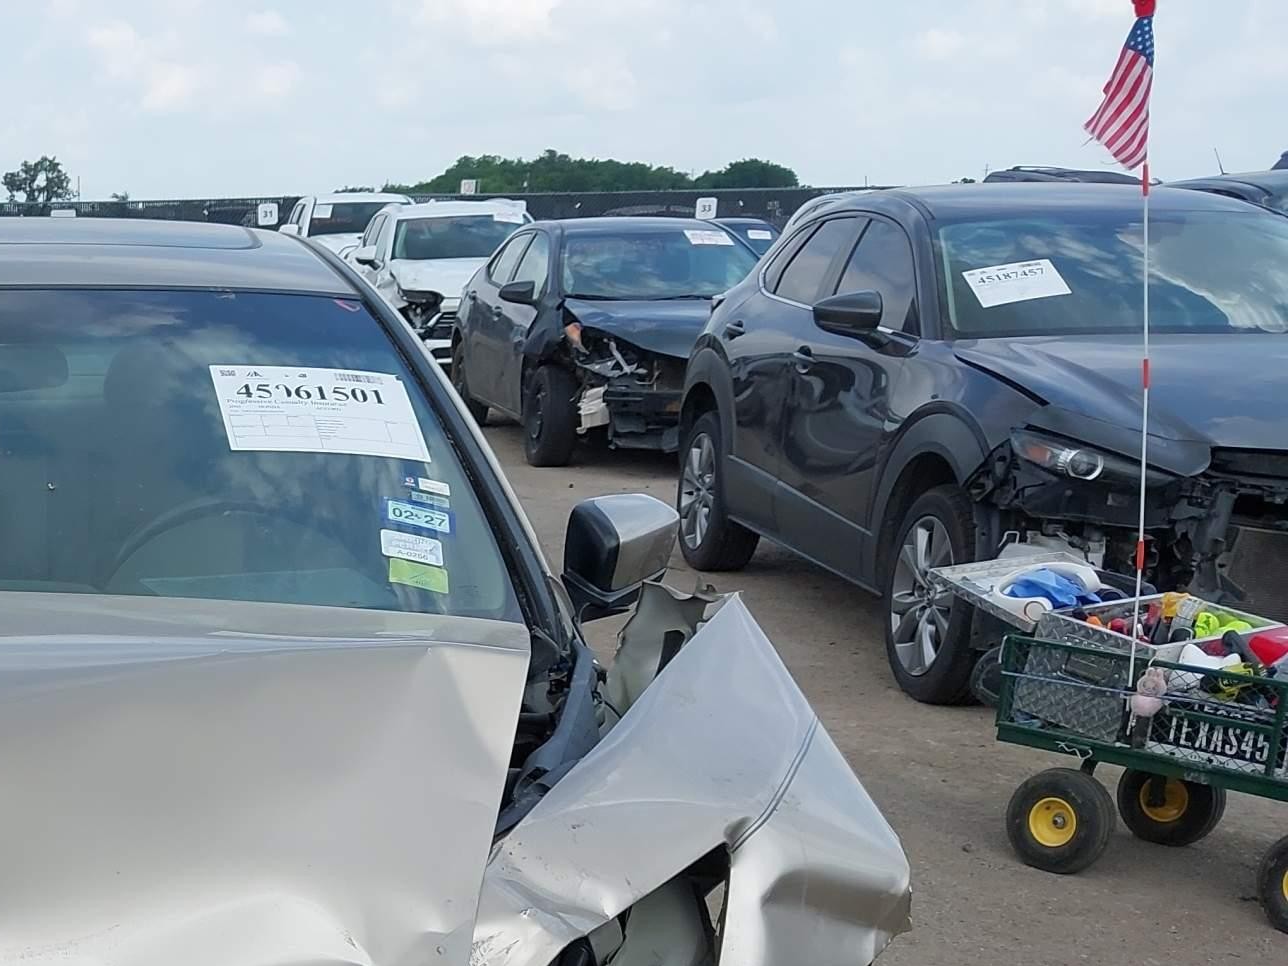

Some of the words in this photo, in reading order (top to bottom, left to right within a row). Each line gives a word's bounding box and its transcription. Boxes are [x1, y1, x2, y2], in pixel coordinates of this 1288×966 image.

[263, 210, 273, 218] 31
[701, 204, 712, 213] 33
[977, 267, 1045, 284] 45187457
[392, 507, 416, 521] 02
[424, 514, 447, 527] 27
